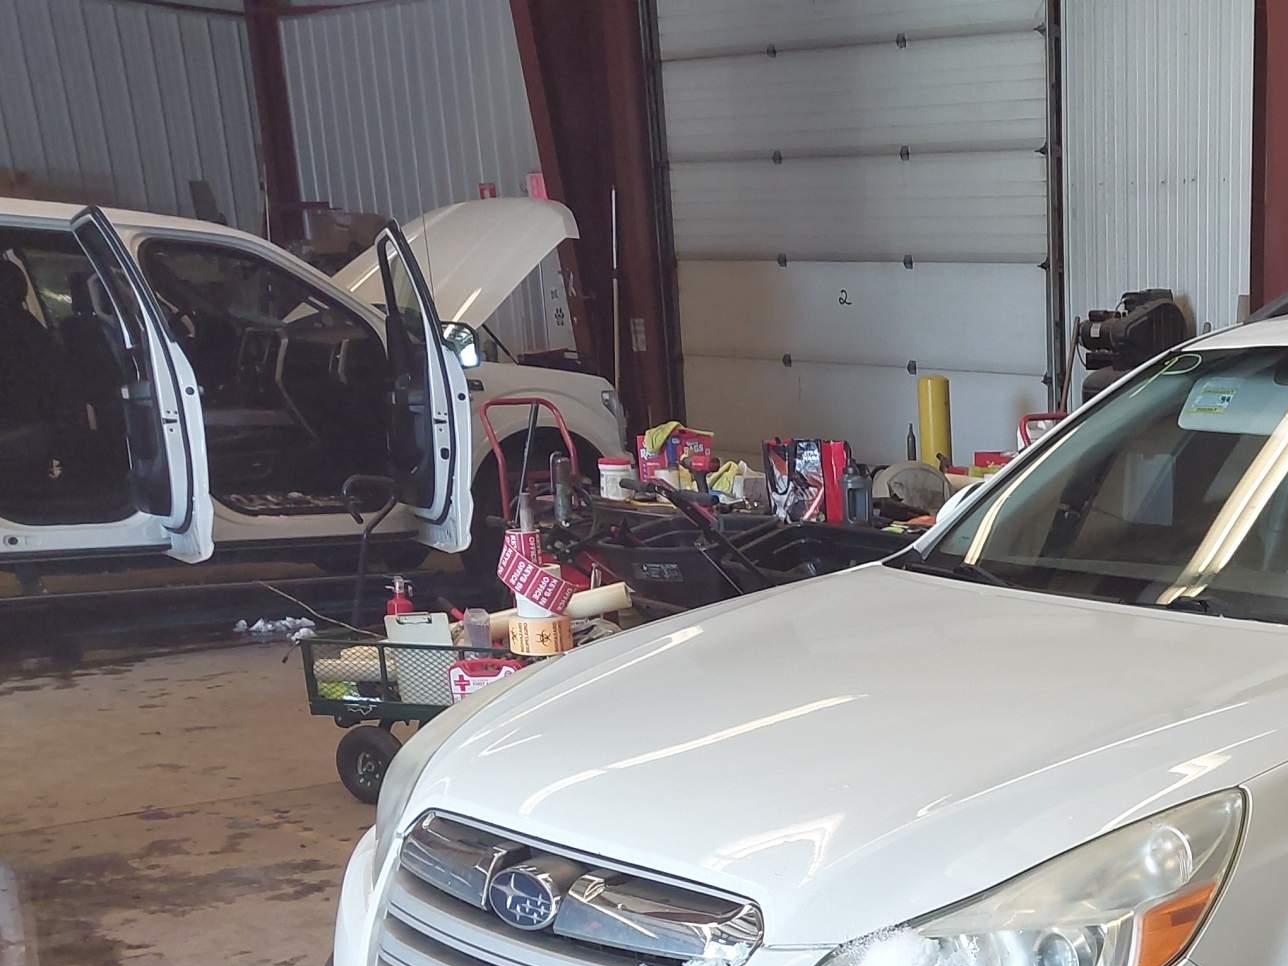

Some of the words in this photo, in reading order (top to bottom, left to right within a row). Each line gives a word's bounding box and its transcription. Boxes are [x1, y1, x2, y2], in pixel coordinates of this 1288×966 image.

[838, 289, 853, 305] 2
[510, 561, 525, 586] OFFICE
[520, 563, 534, 583] KEYS
[532, 576, 550, 600] OFFICE
[545, 578, 558, 597] KEYS
